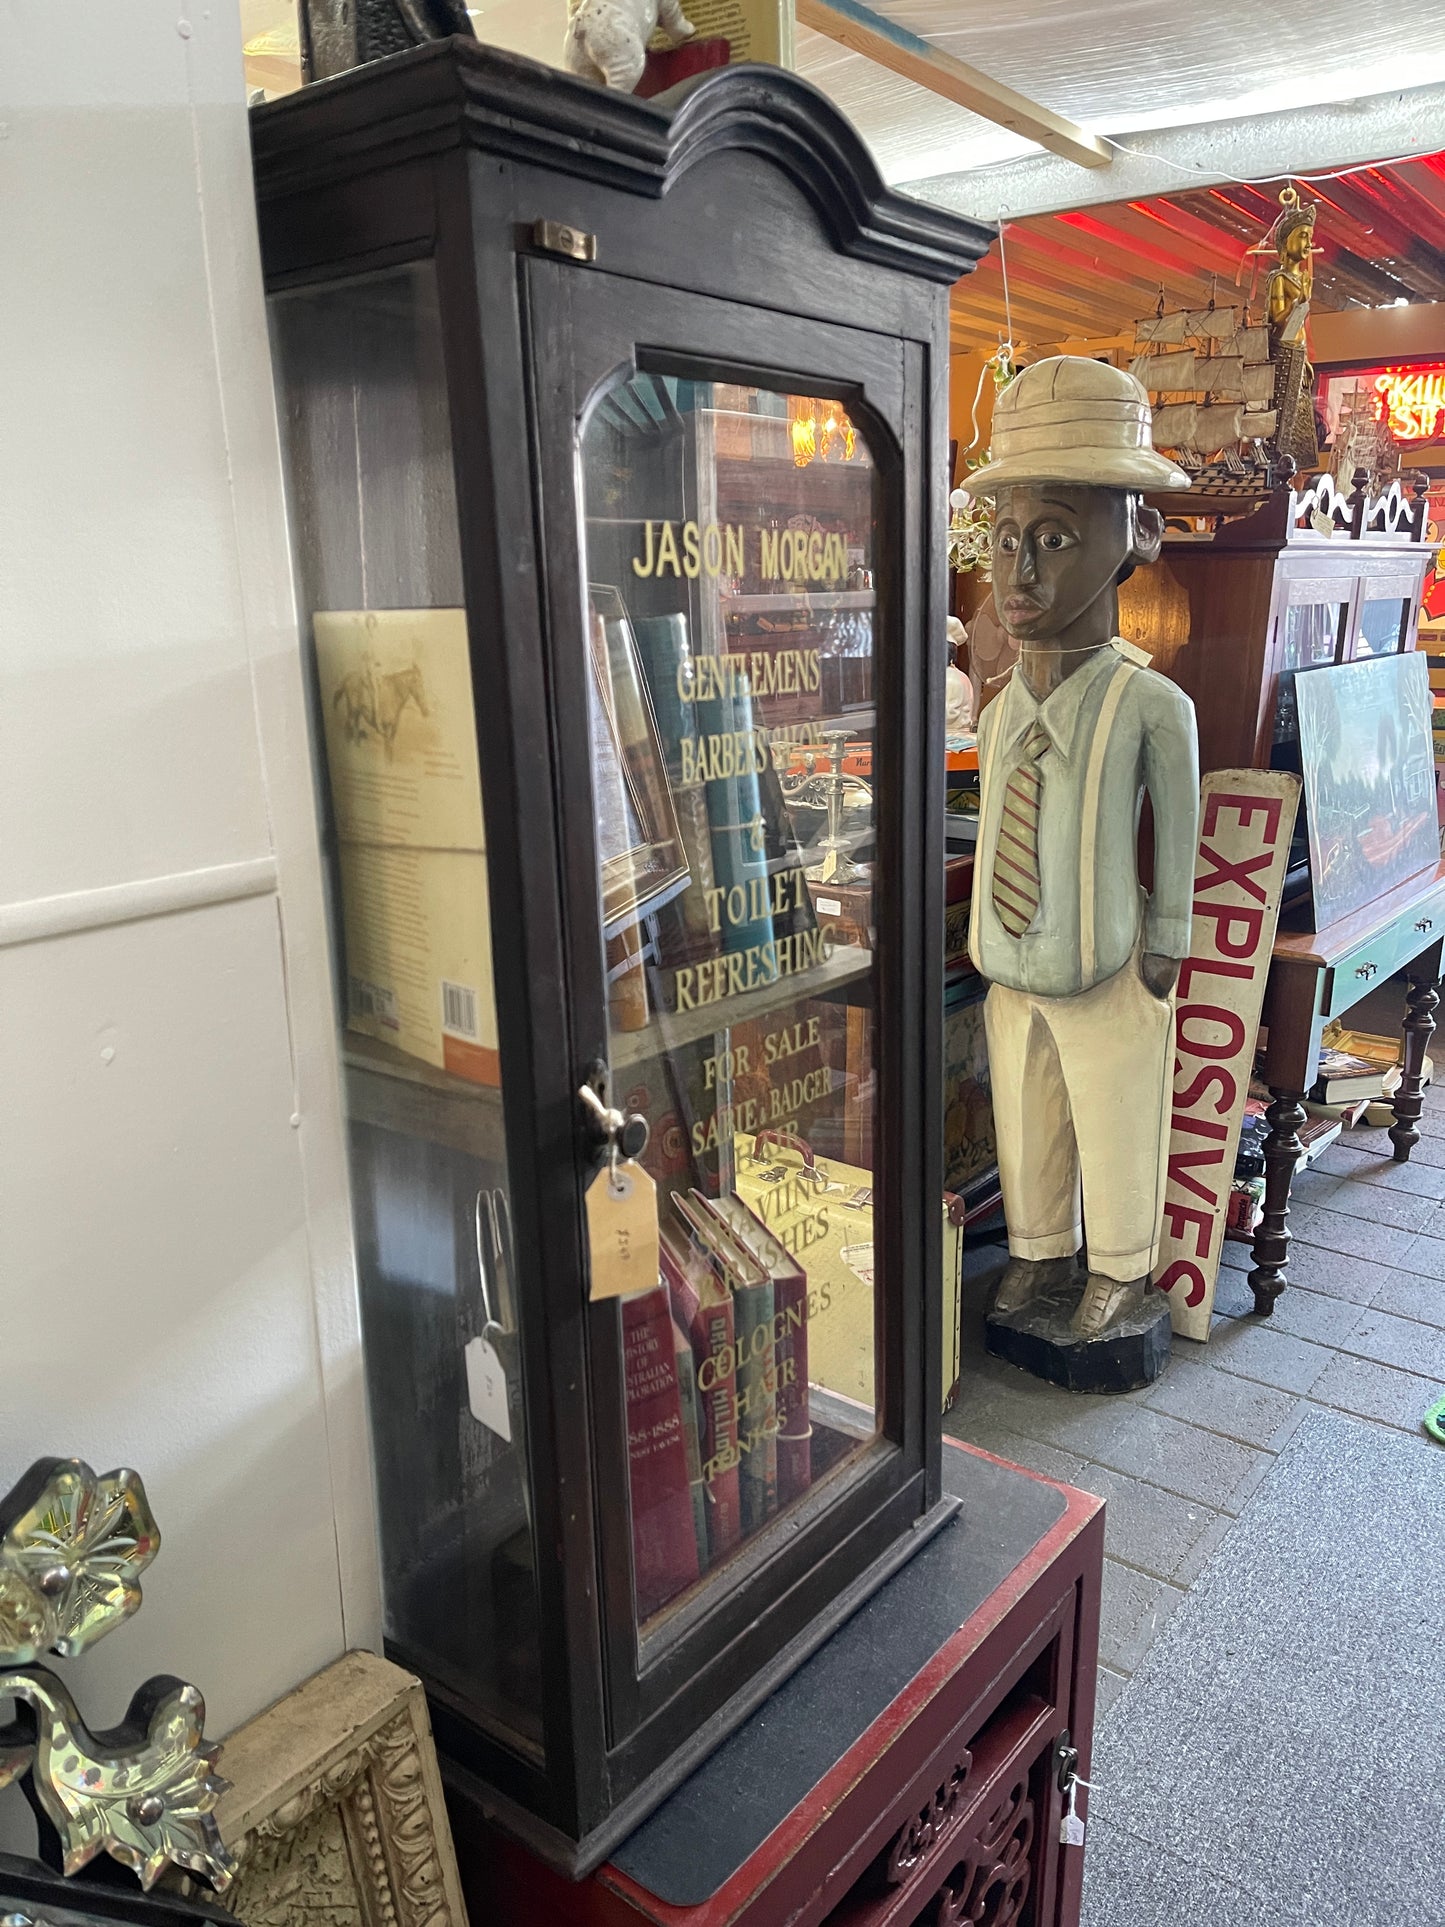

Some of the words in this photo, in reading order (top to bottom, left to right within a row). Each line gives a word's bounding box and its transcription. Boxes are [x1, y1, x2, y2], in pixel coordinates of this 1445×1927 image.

[632, 520, 745, 579] JASON
[761, 528, 849, 580] MORGAN
[677, 649, 820, 702] GENTLEMENS
[680, 729, 768, 784] BARBERS
[704, 866, 806, 932] TOILET
[675, 924, 836, 1014] REFRESHING
[703, 1046, 749, 1090] FOR
[763, 1017, 821, 1065] SALE
[1154, 792, 1283, 1309] EXPLOSIVES
[769, 1066, 833, 1119] BADGER
[631, 1327, 651, 1344] THE
[636, 1357, 649, 1371] OF
[698, 1282, 831, 1391] COLOGNES
